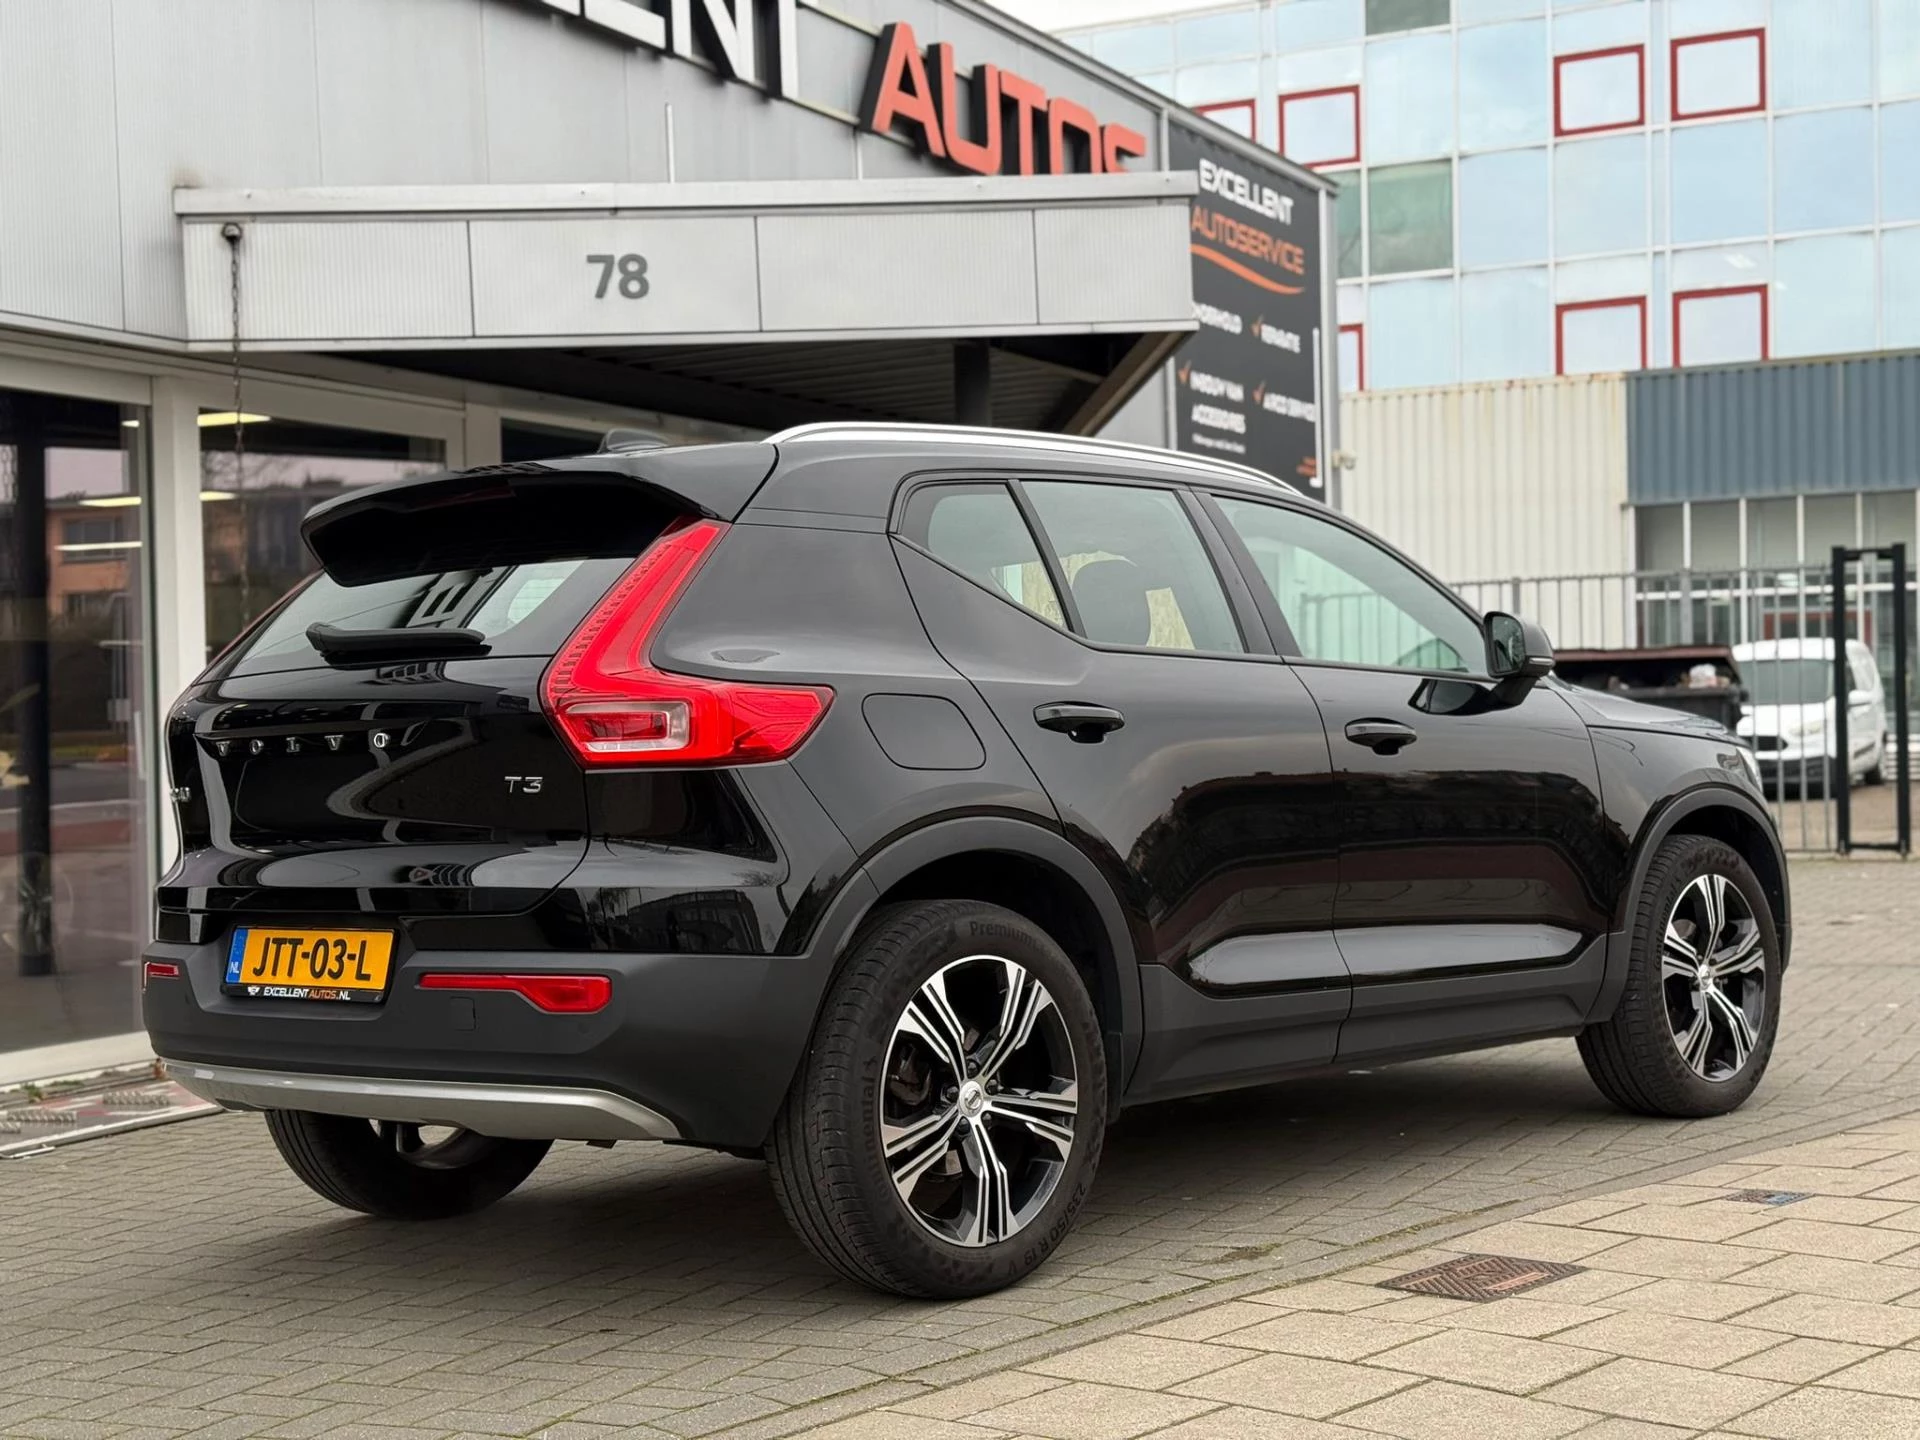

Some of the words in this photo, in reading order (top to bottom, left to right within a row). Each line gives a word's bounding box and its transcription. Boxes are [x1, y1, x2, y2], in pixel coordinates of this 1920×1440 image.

[1199, 157, 1294, 225] EXCELLENT
[1190, 205, 1305, 275] AUTOSERVICE
[586, 254, 650, 300] 78
[215, 732, 391, 757] VOLVO
[504, 775, 544, 794] T3
[229, 961, 240, 974] NL
[252, 936, 372, 982] JTT-03-L
